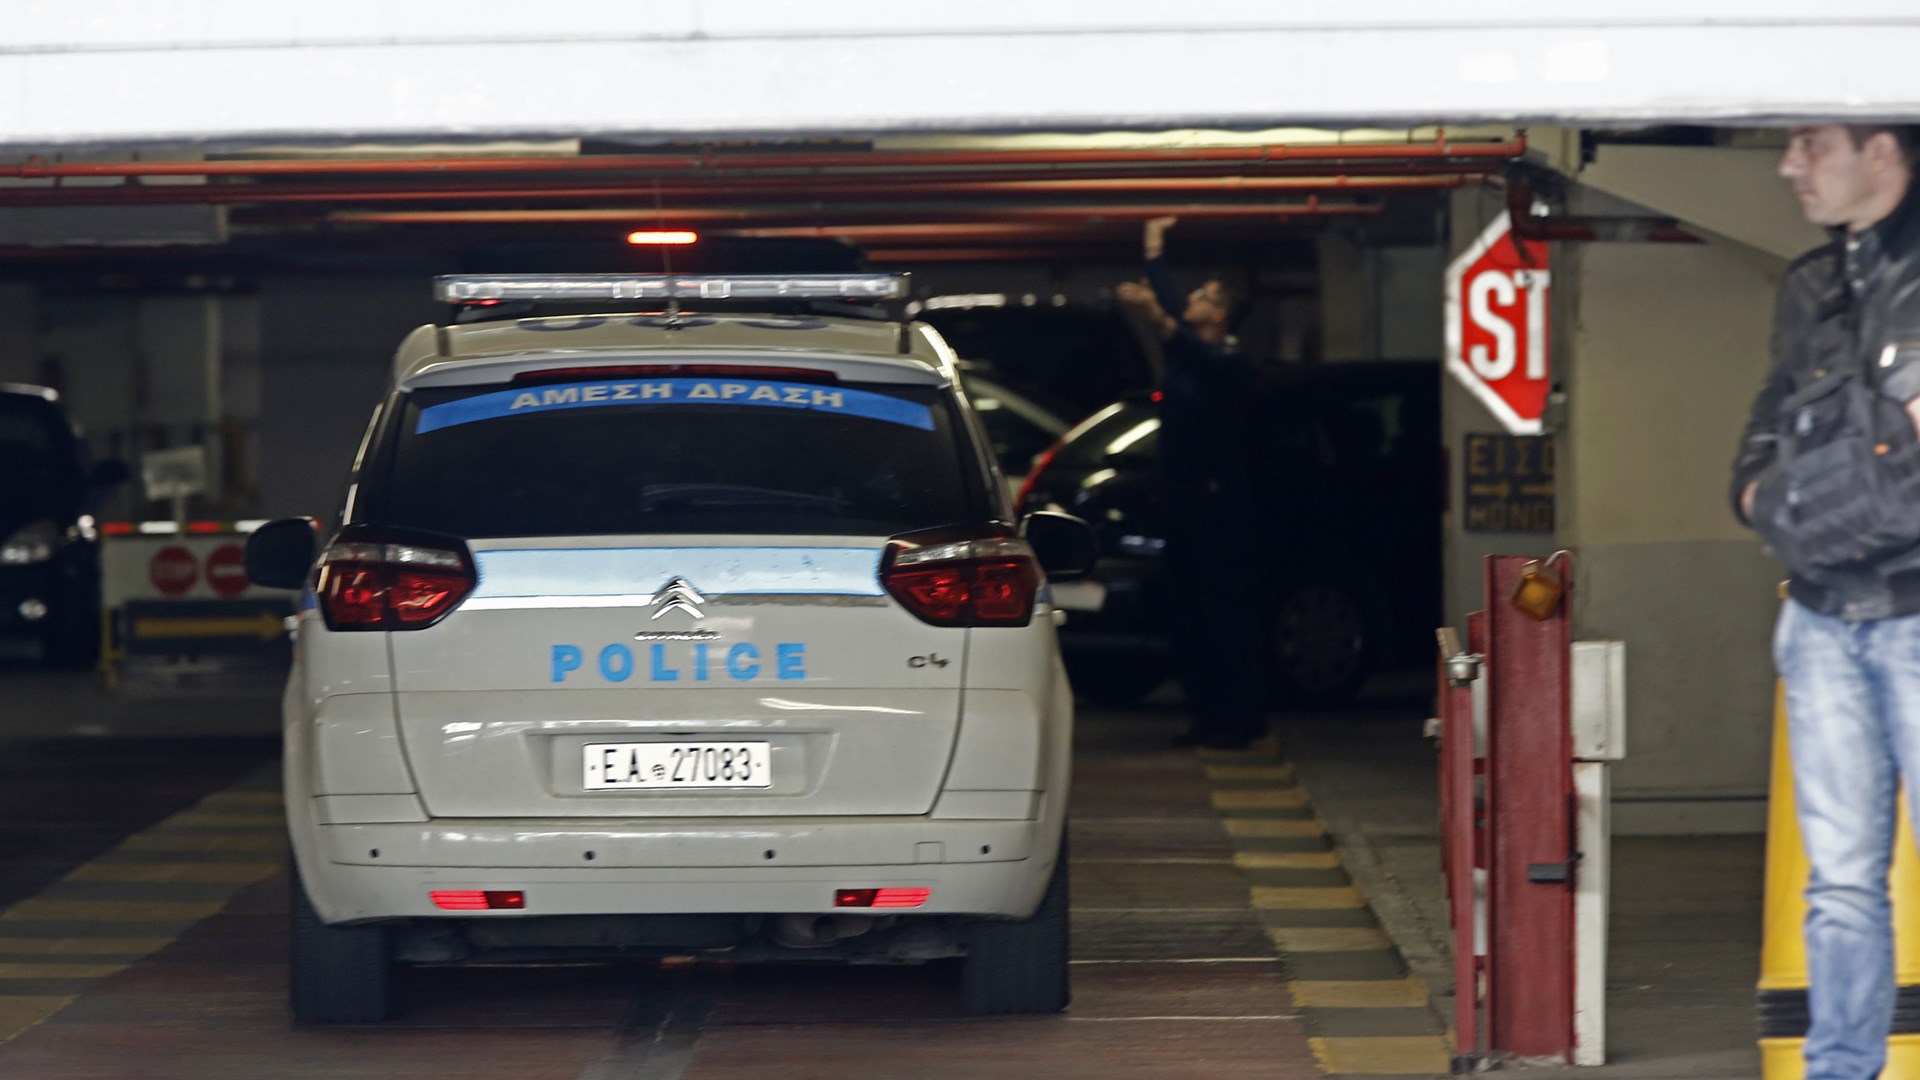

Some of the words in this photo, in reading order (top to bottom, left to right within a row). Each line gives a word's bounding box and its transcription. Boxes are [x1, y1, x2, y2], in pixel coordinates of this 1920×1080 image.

[508, 381, 673, 411] ΑΜΕΣΗ
[687, 382, 845, 408] ΔΡΑΣΗ
[551, 642, 808, 683] POLICE
[906, 652, 952, 669] C4
[669, 747, 752, 783] 27083
